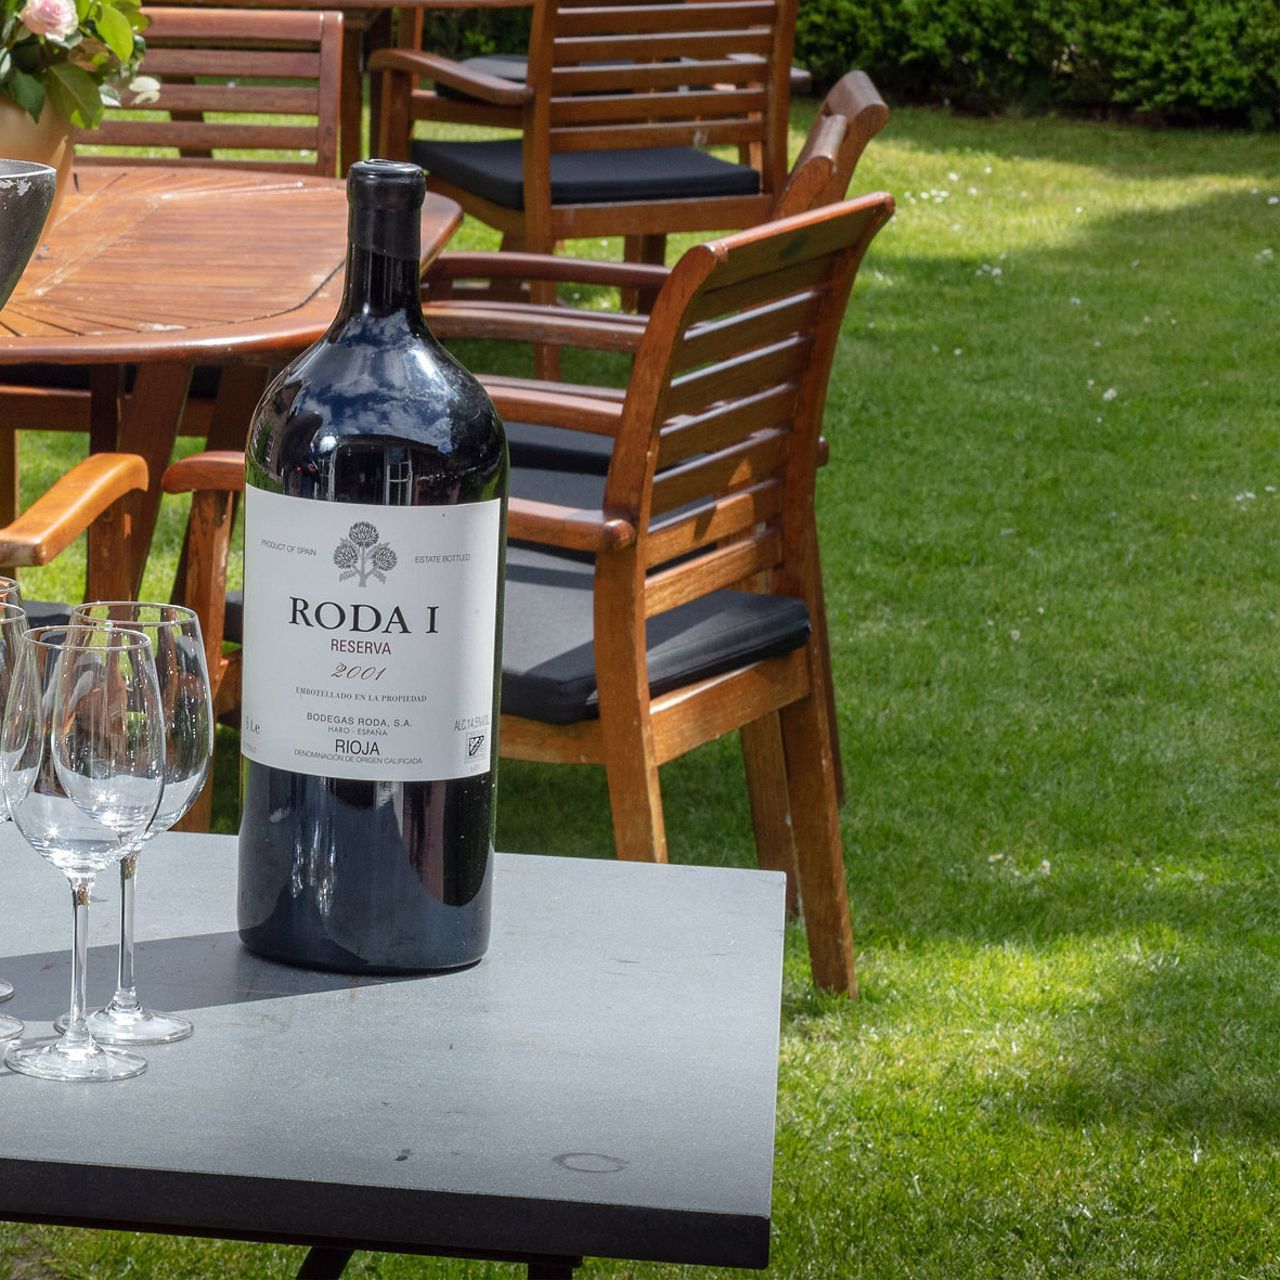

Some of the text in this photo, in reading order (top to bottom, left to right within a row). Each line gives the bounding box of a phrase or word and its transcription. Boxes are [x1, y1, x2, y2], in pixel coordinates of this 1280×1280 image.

[261, 539, 317, 557] PRODUCT OF SPAIN
[415, 554, 471, 564] ESTATE BOTTLED
[288, 596, 440, 634] RODA I
[330, 638, 392, 655] RESERVA
[331, 662, 387, 680] 2001
[295, 686, 352, 700] EMBOTELLADO
[354, 693, 366, 701] EN
[306, 712, 412, 728] BODEGAS RODA, S.A.
[328, 726, 350, 734] HARO
[357, 727, 388, 736] ESPAÑA
[335, 739, 380, 756] RIOJA
[355, 756, 383, 764] ORIGEN
[385, 757, 423, 765] CALIFICADA
